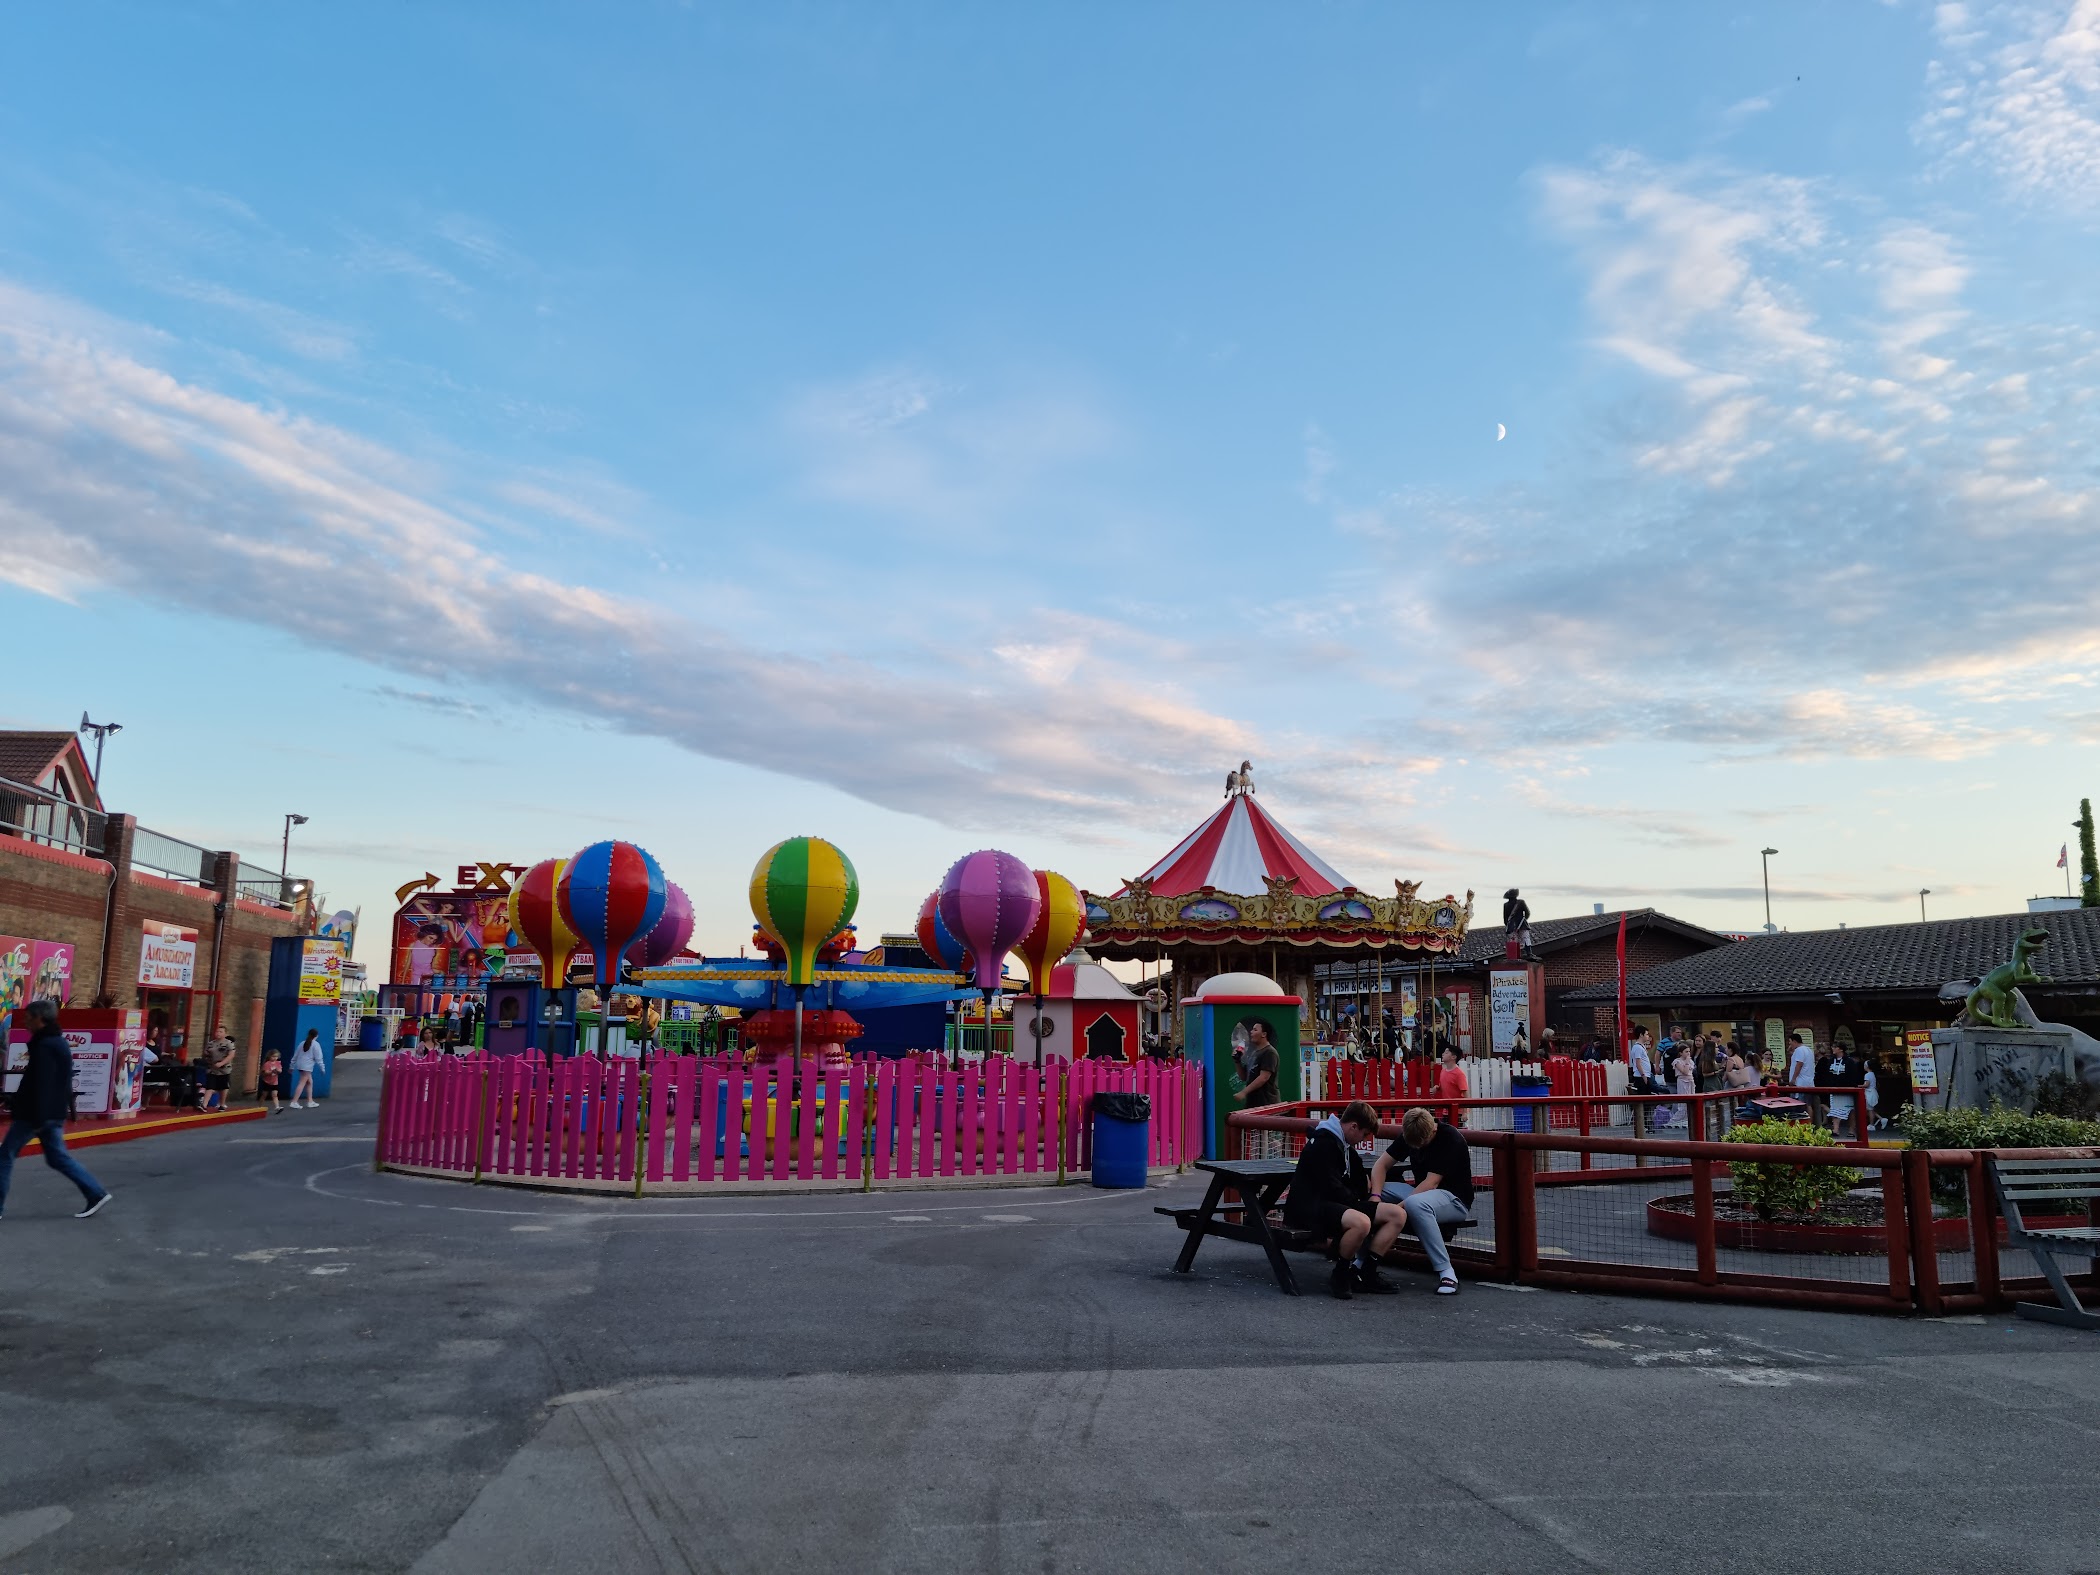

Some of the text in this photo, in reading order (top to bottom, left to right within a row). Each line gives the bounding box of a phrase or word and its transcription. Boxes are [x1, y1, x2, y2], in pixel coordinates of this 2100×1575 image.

[154, 964, 180, 979] ARCADE
[1335, 981, 1349, 992] FISH
[1351, 981, 1357, 992] &
[1493, 1000, 1516, 1013] Golf
[1907, 1034, 1930, 1042] NOTICE
